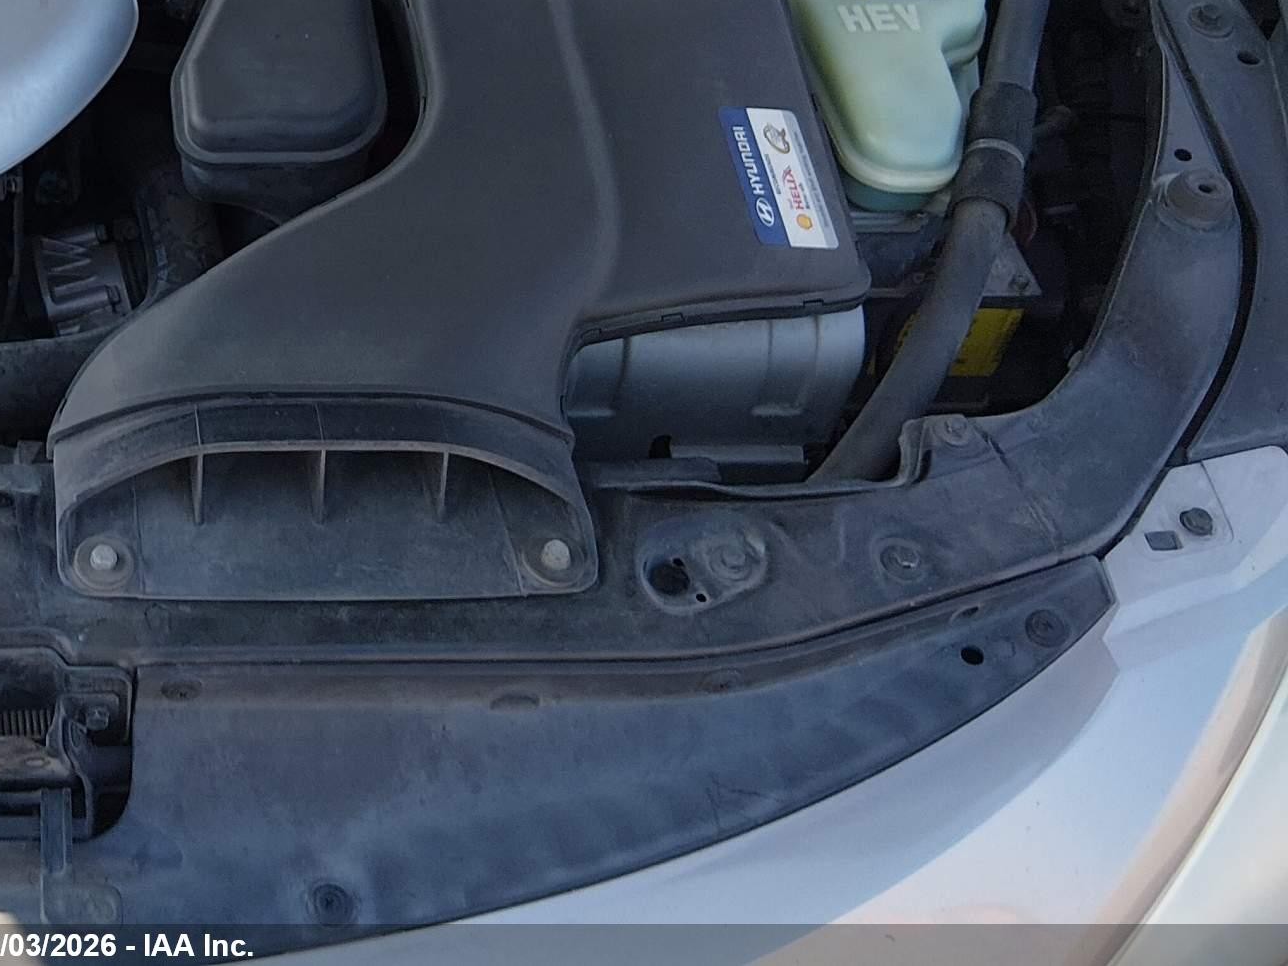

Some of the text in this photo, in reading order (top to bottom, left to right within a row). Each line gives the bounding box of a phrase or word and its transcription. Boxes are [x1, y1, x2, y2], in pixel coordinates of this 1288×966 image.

[837, 2, 921, 33] HEV
[731, 124, 766, 196] HYUNDAI
[782, 166, 805, 211] HELIX
